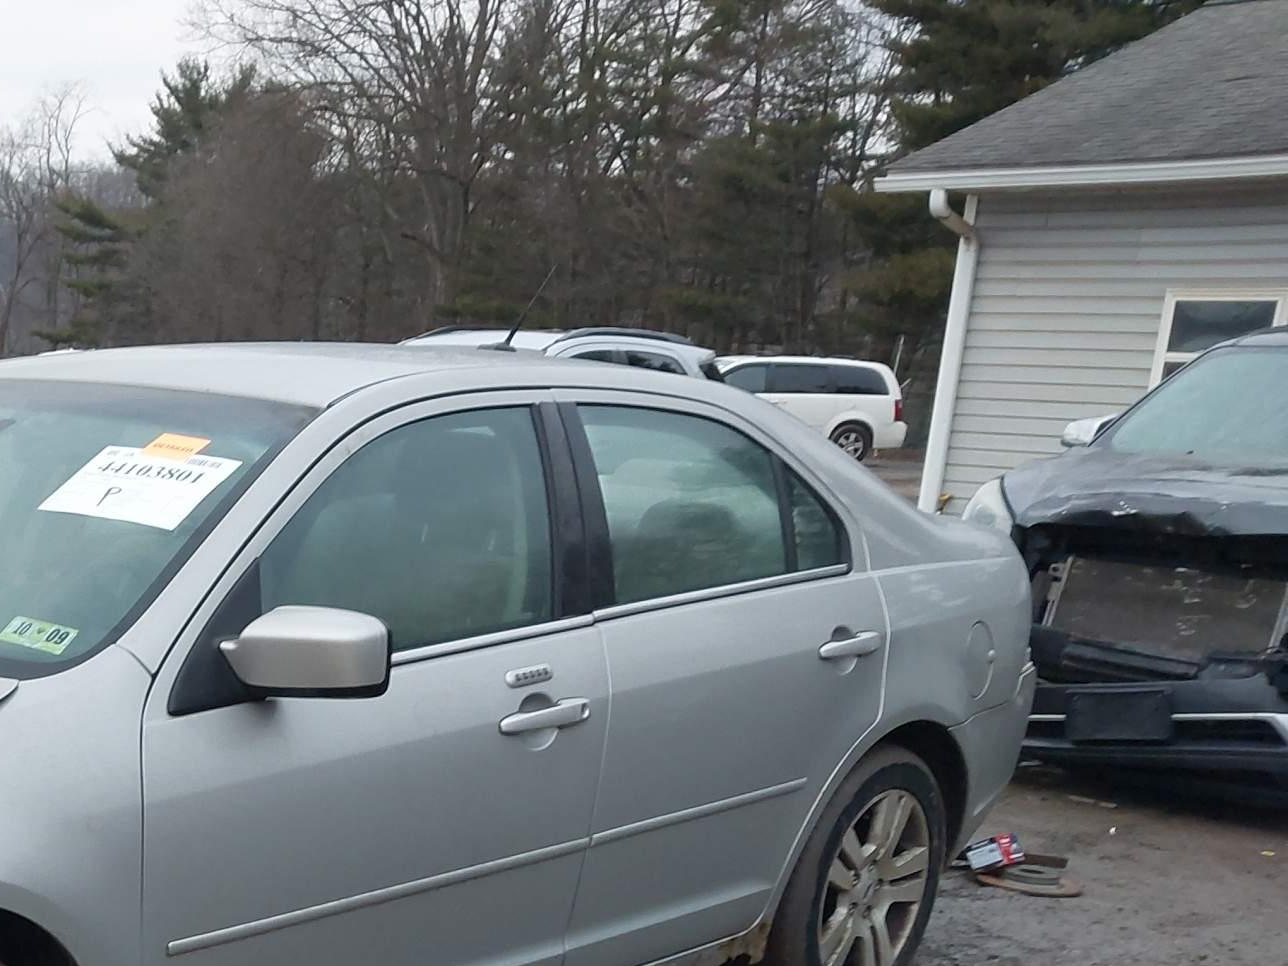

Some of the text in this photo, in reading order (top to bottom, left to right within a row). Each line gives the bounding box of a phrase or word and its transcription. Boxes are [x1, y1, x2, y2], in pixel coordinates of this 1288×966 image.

[99, 461, 204, 483] 44103801
[97, 487, 122, 506] P
[13, 622, 69, 644] 10 09
